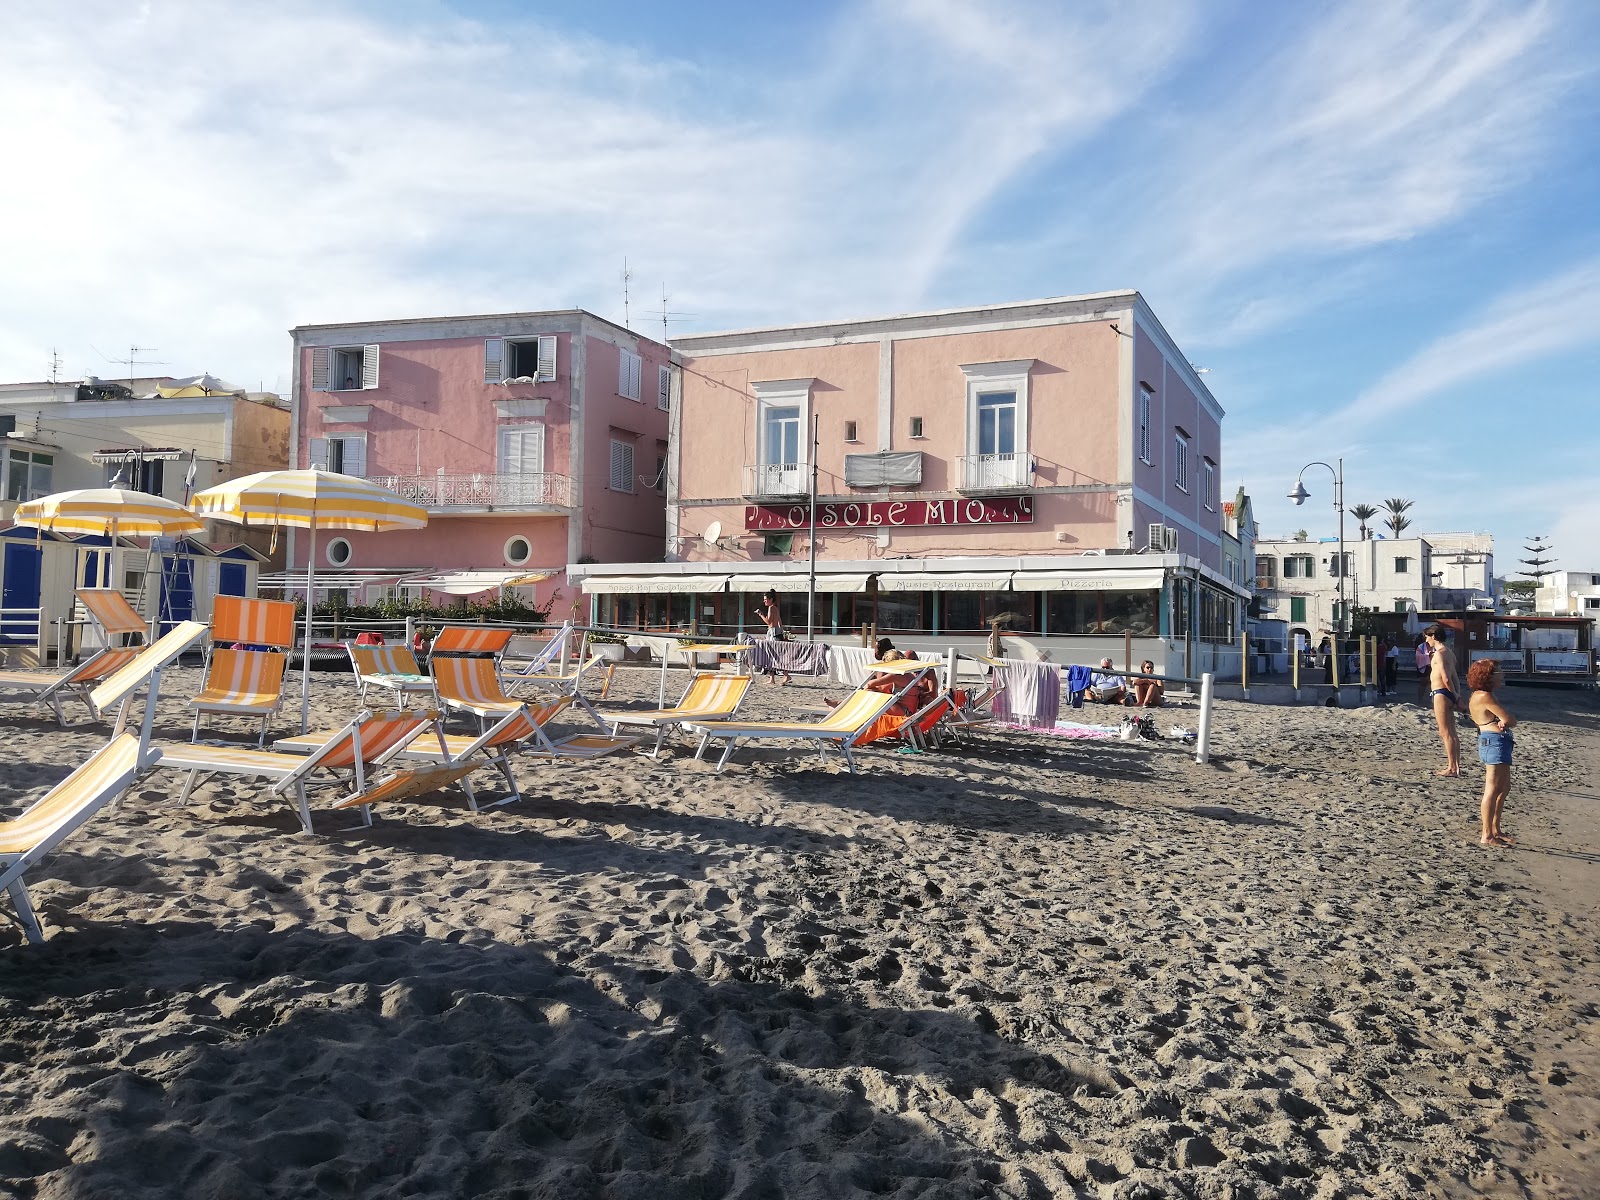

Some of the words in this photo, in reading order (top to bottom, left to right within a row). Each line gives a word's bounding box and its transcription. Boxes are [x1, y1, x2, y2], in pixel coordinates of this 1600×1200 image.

[821, 502, 908, 526] SOLE
[924, 499, 985, 523] MIO
[637, 583, 653, 593] Bar
[656, 583, 698, 592] Gelateria
[804, 582, 823, 590] Mo
[896, 580, 928, 590] Music
[932, 580, 994, 590] Restaurant
[1060, 579, 1113, 589] Pizzeria
